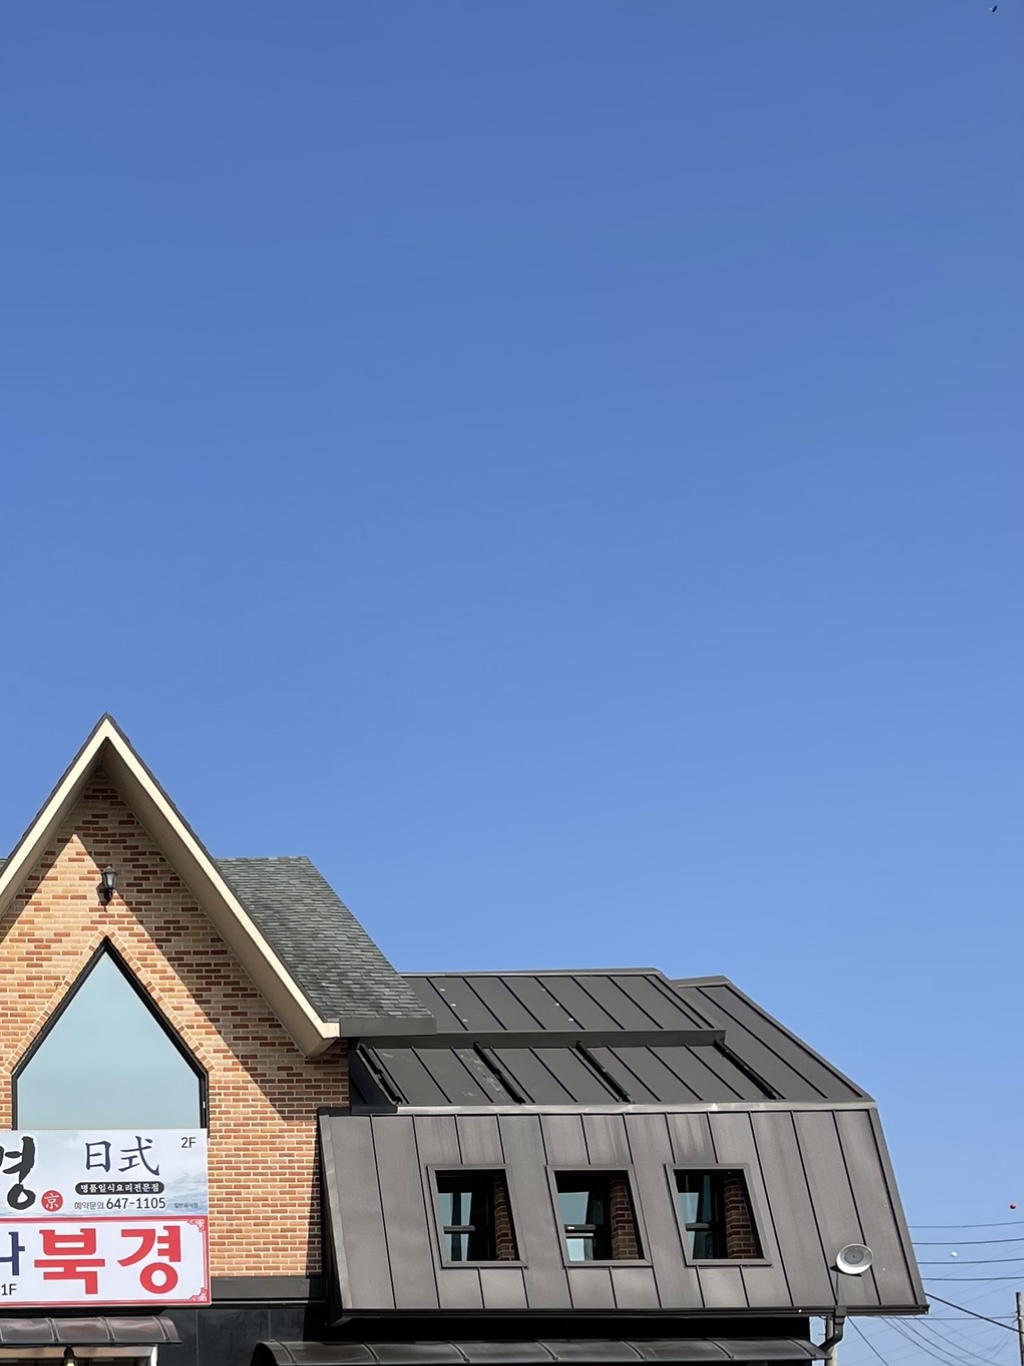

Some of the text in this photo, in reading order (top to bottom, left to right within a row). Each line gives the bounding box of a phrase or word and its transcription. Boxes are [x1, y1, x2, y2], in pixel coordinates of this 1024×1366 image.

[181, 1137, 196, 1148] 2F
[85, 1135, 160, 1176] 日式
[44, 1193, 61, 1210] 京
[106, 1197, 166, 1210] 647-1105
[34, 1225, 182, 1295] 북경
[1, 1283, 18, 1296] 1F
